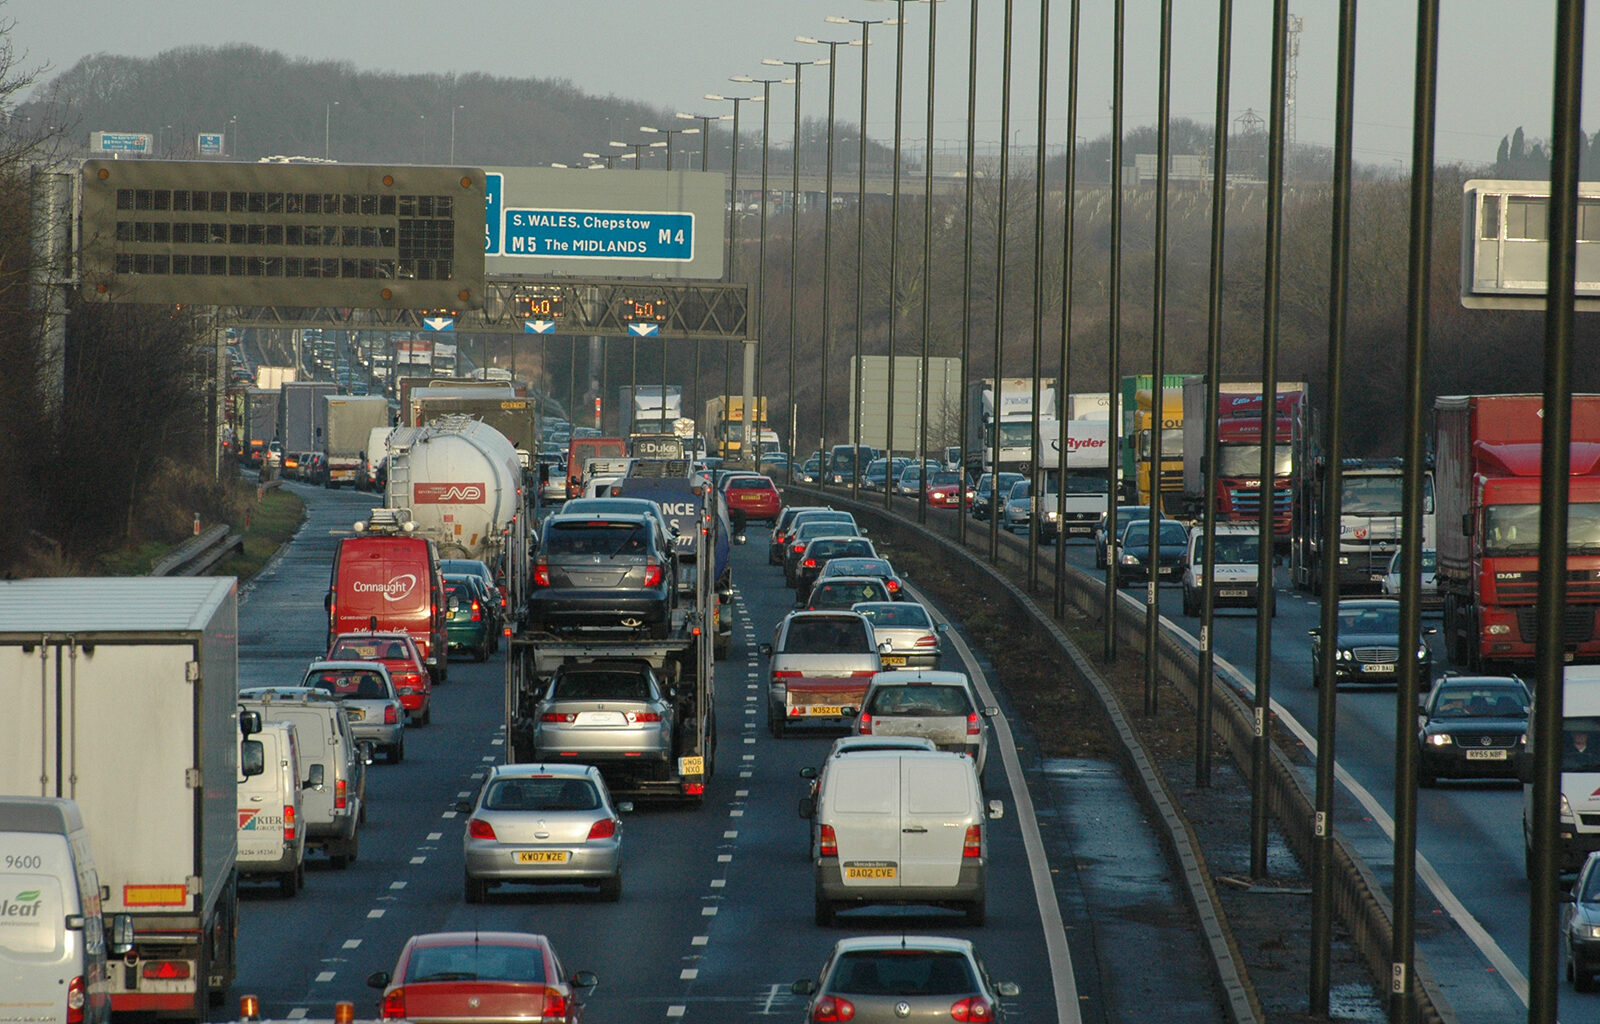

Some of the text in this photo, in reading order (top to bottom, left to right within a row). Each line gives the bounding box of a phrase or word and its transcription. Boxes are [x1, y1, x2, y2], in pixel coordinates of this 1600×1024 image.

[512, 214, 526, 227] S.
[583, 216, 651, 230] Chepstow
[658, 228, 685, 245] M4
[512, 236, 648, 253] M5 The MIDLANDS
[530, 300, 551, 315] 40
[634, 302, 654, 317] 40
[646, 443, 677, 453] Duke
[1066, 437, 1107, 450] Ryder
[656, 502, 695, 516] NCE
[352, 581, 407, 595] Connaught
[812, 706, 831, 714] N352
[257, 816, 282, 825] KIER
[1316, 812, 1324, 834] 99
[5, 855, 42, 869] 9600
[521, 853, 563, 862] KW07 WZE
[875, 868, 893, 878] CVE
[0, 900, 42, 917] leaf
[1393, 964, 1402, 991] 98
